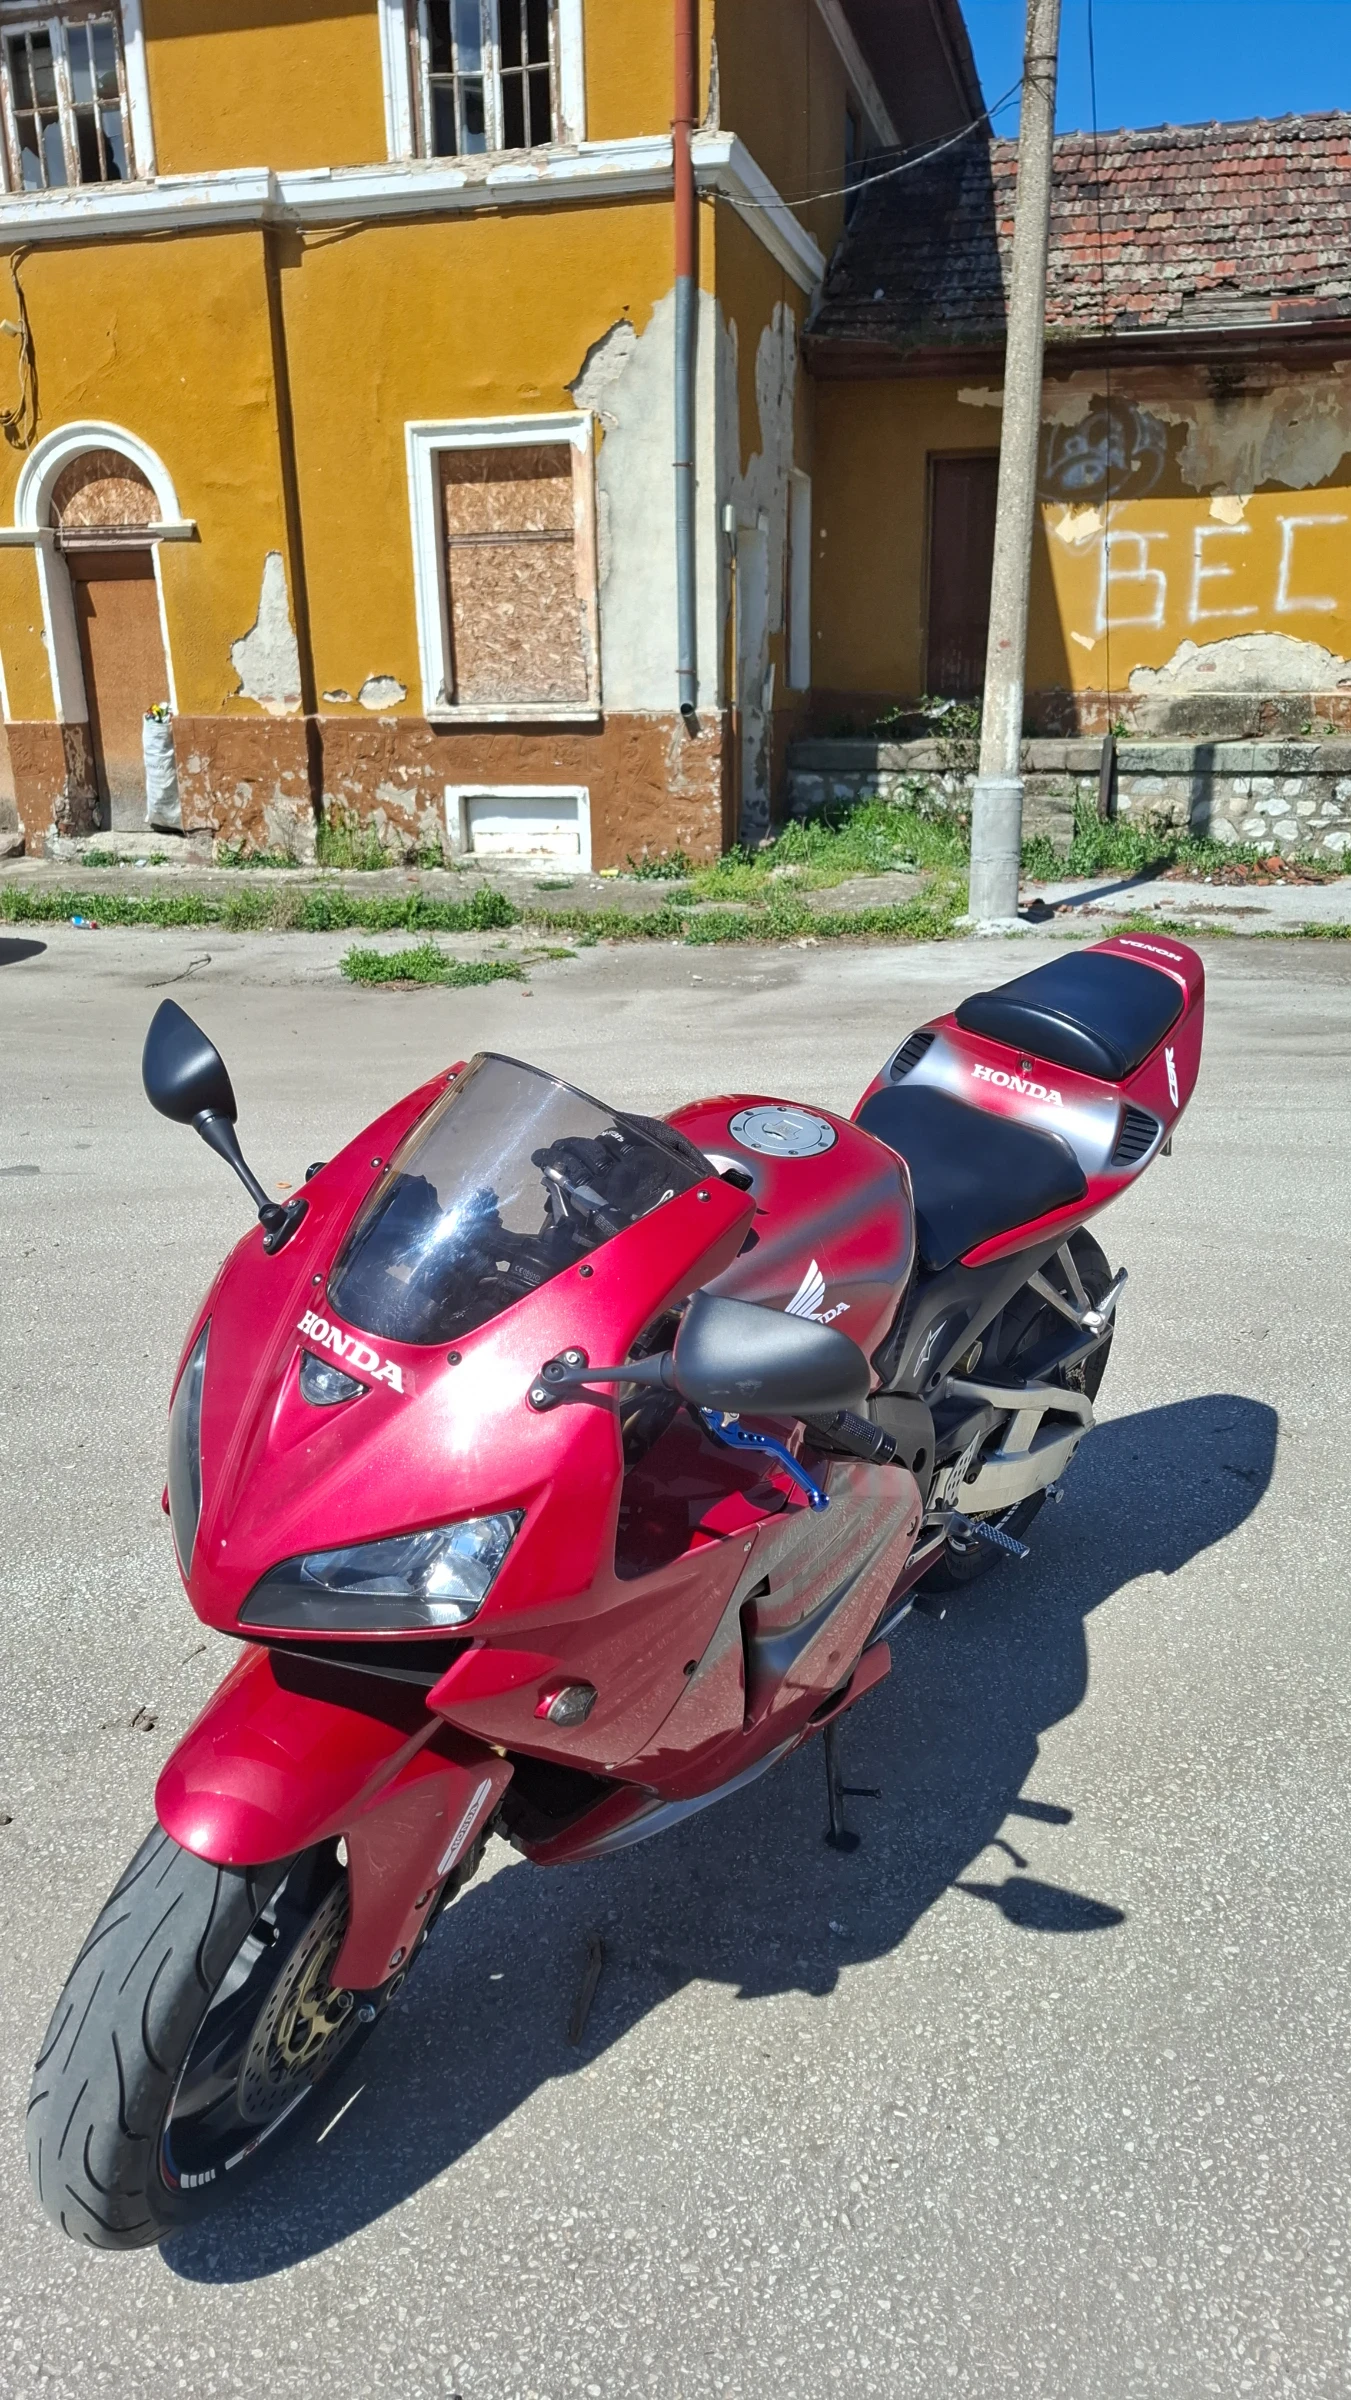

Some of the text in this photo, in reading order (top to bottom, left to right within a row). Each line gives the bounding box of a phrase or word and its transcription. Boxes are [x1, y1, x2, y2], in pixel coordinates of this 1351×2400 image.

[1119, 939, 1184, 962] HONDA
[970, 1063, 1065, 1108] HONDA
[1165, 1047, 1179, 1108] CBR
[297, 1310, 404, 1394] HONDA
[452, 1803, 480, 1851] HONDA
